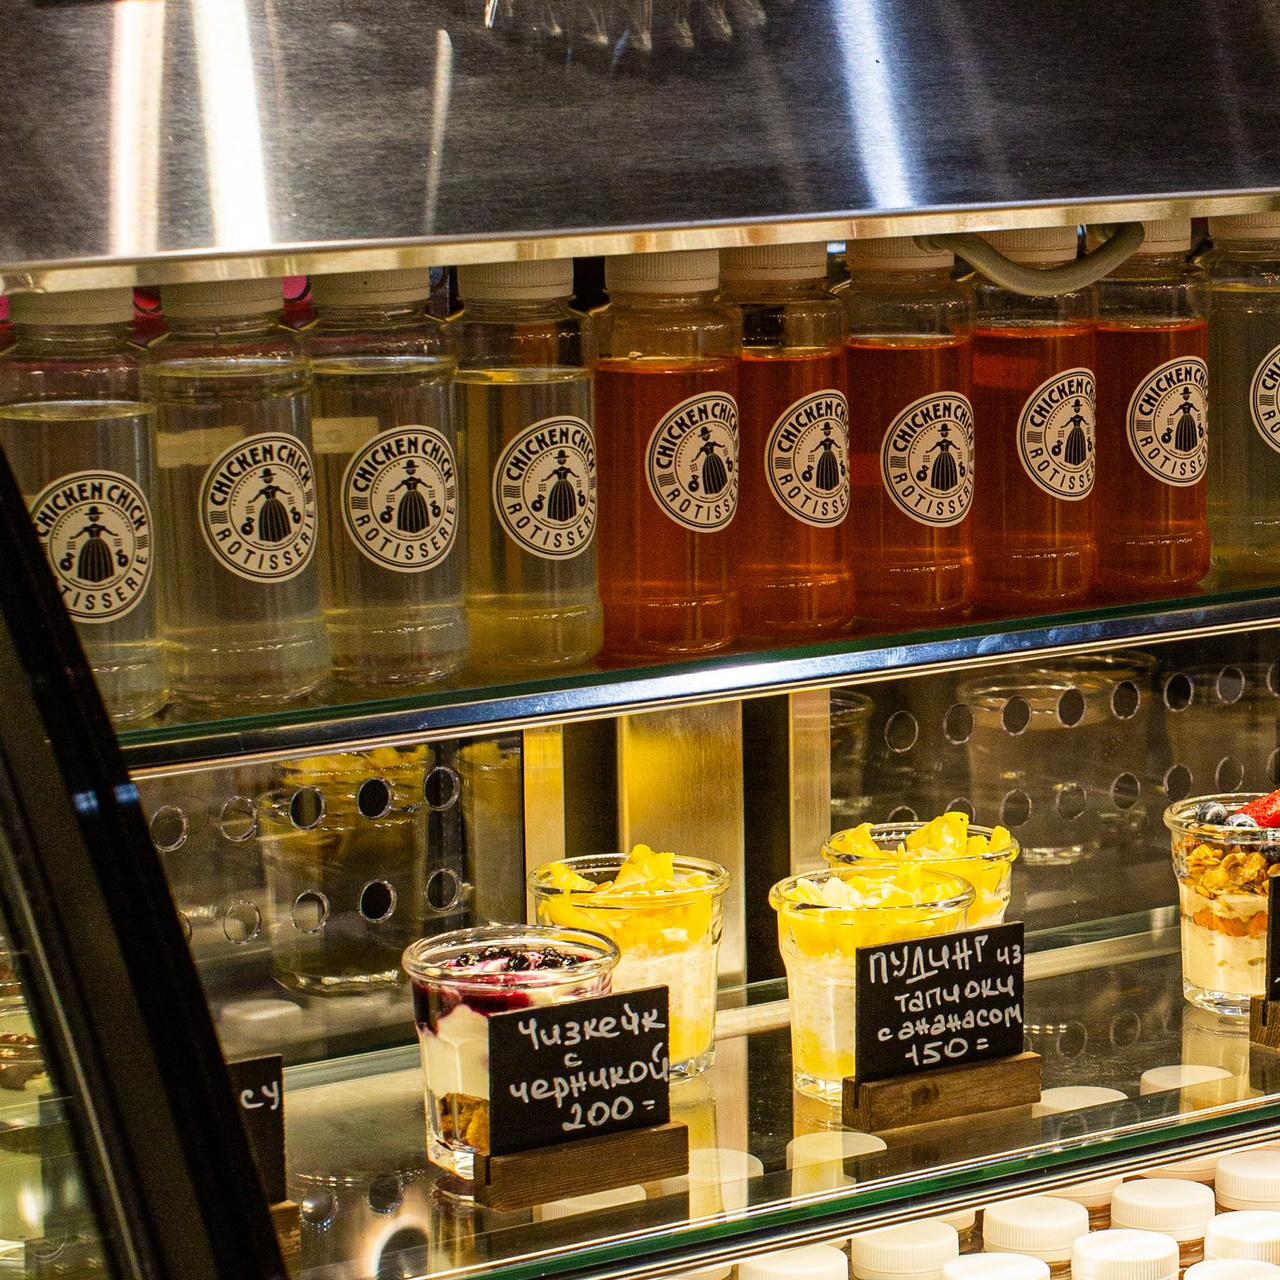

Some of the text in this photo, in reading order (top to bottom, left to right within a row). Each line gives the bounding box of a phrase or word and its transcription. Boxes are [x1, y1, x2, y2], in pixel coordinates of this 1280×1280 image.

[1030, 378, 1083, 427] CHICKEN
[1139, 367, 1191, 416] CHICKEN
[656, 405, 708, 469] CHICKEN
[775, 400, 832, 453] CHICKEN
[893, 402, 951, 452] CHICKEN
[210, 444, 312, 506] CHICKEN CHICK
[352, 436, 454, 492] CHICKEN CHICK
[505, 427, 595, 481] CHICKEN CHICK
[106, 484, 148, 531] CHICK
[355, 506, 456, 560] ROTISSERIE
[215, 508, 314, 570] ROTISSERIE
[60, 555, 149, 611] TISSERIE
